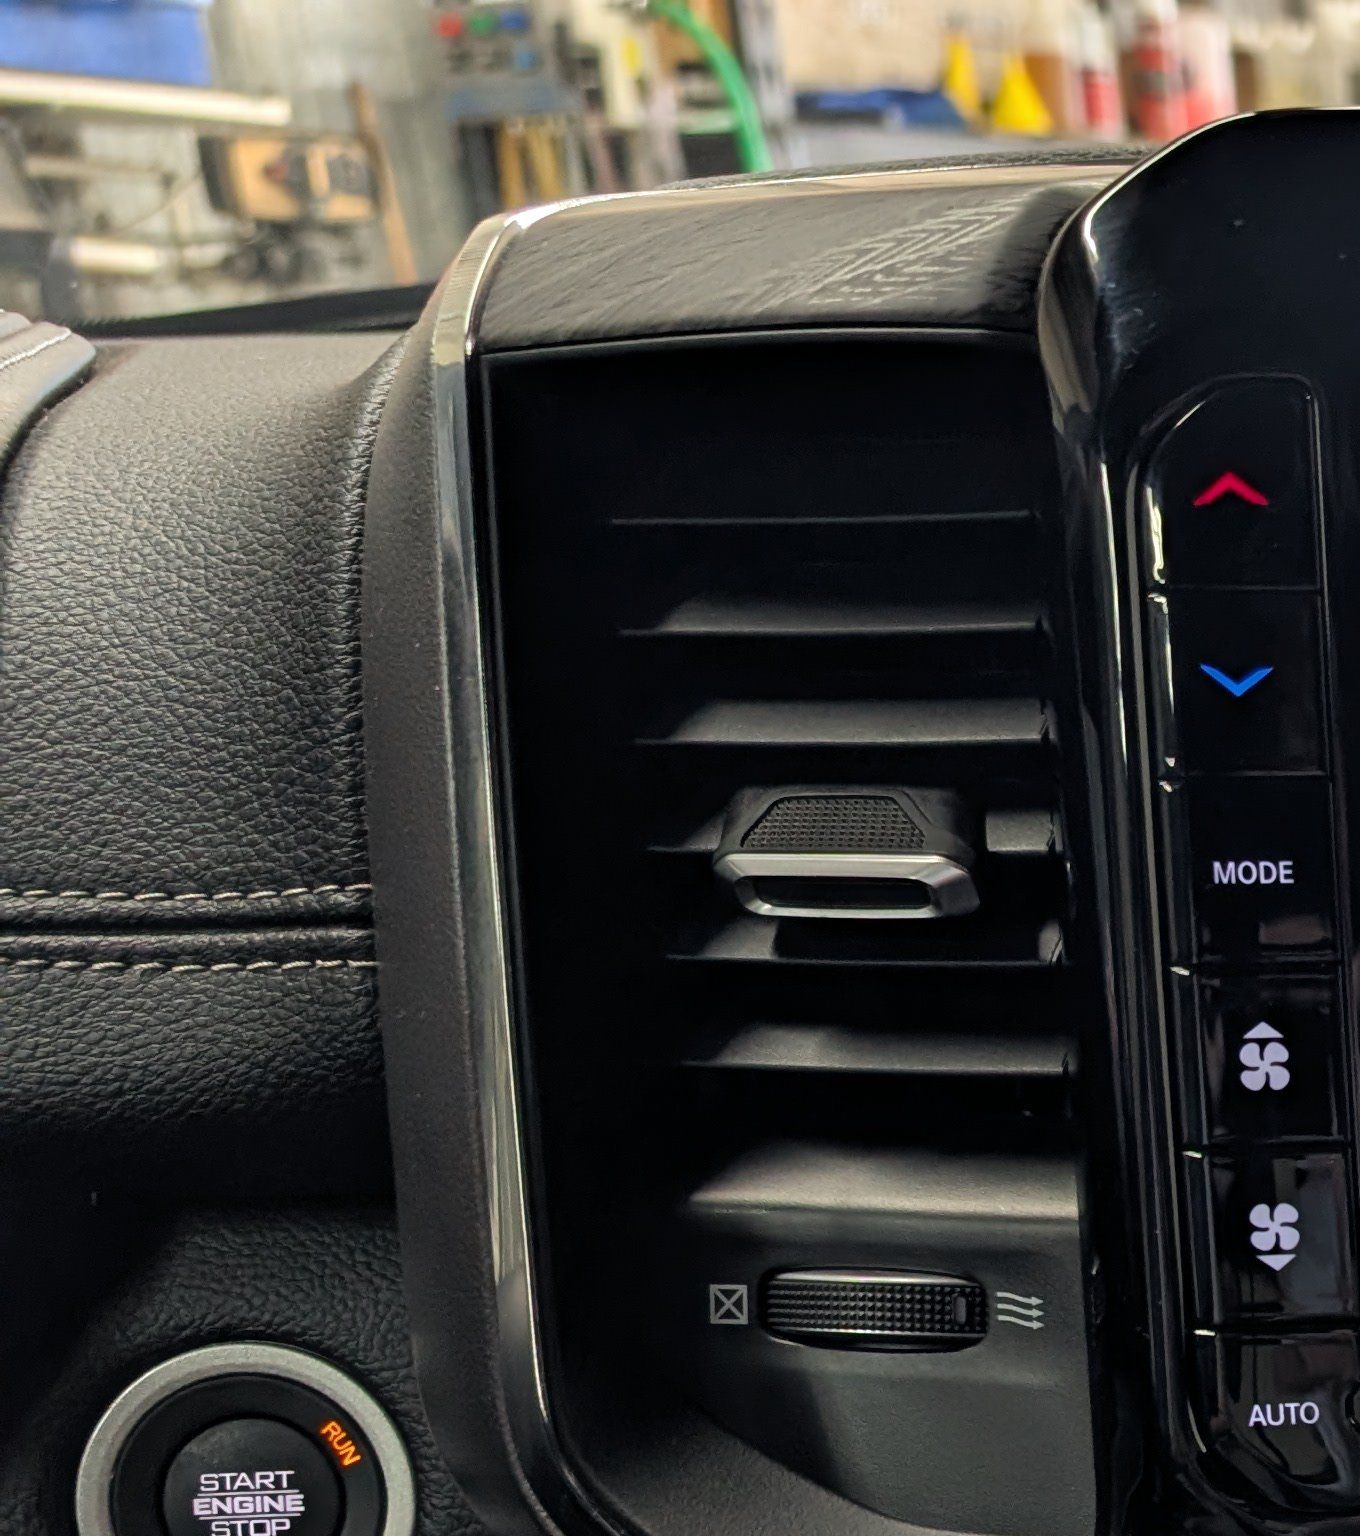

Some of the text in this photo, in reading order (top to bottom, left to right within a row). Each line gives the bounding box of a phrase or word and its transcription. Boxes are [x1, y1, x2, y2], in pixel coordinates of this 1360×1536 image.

[1213, 860, 1295, 885] MODE
[1248, 1401, 1320, 1427] AUTO
[320, 1421, 362, 1466] RUN
[199, 1470, 295, 1492] START
[192, 1494, 306, 1516] ENGINE
